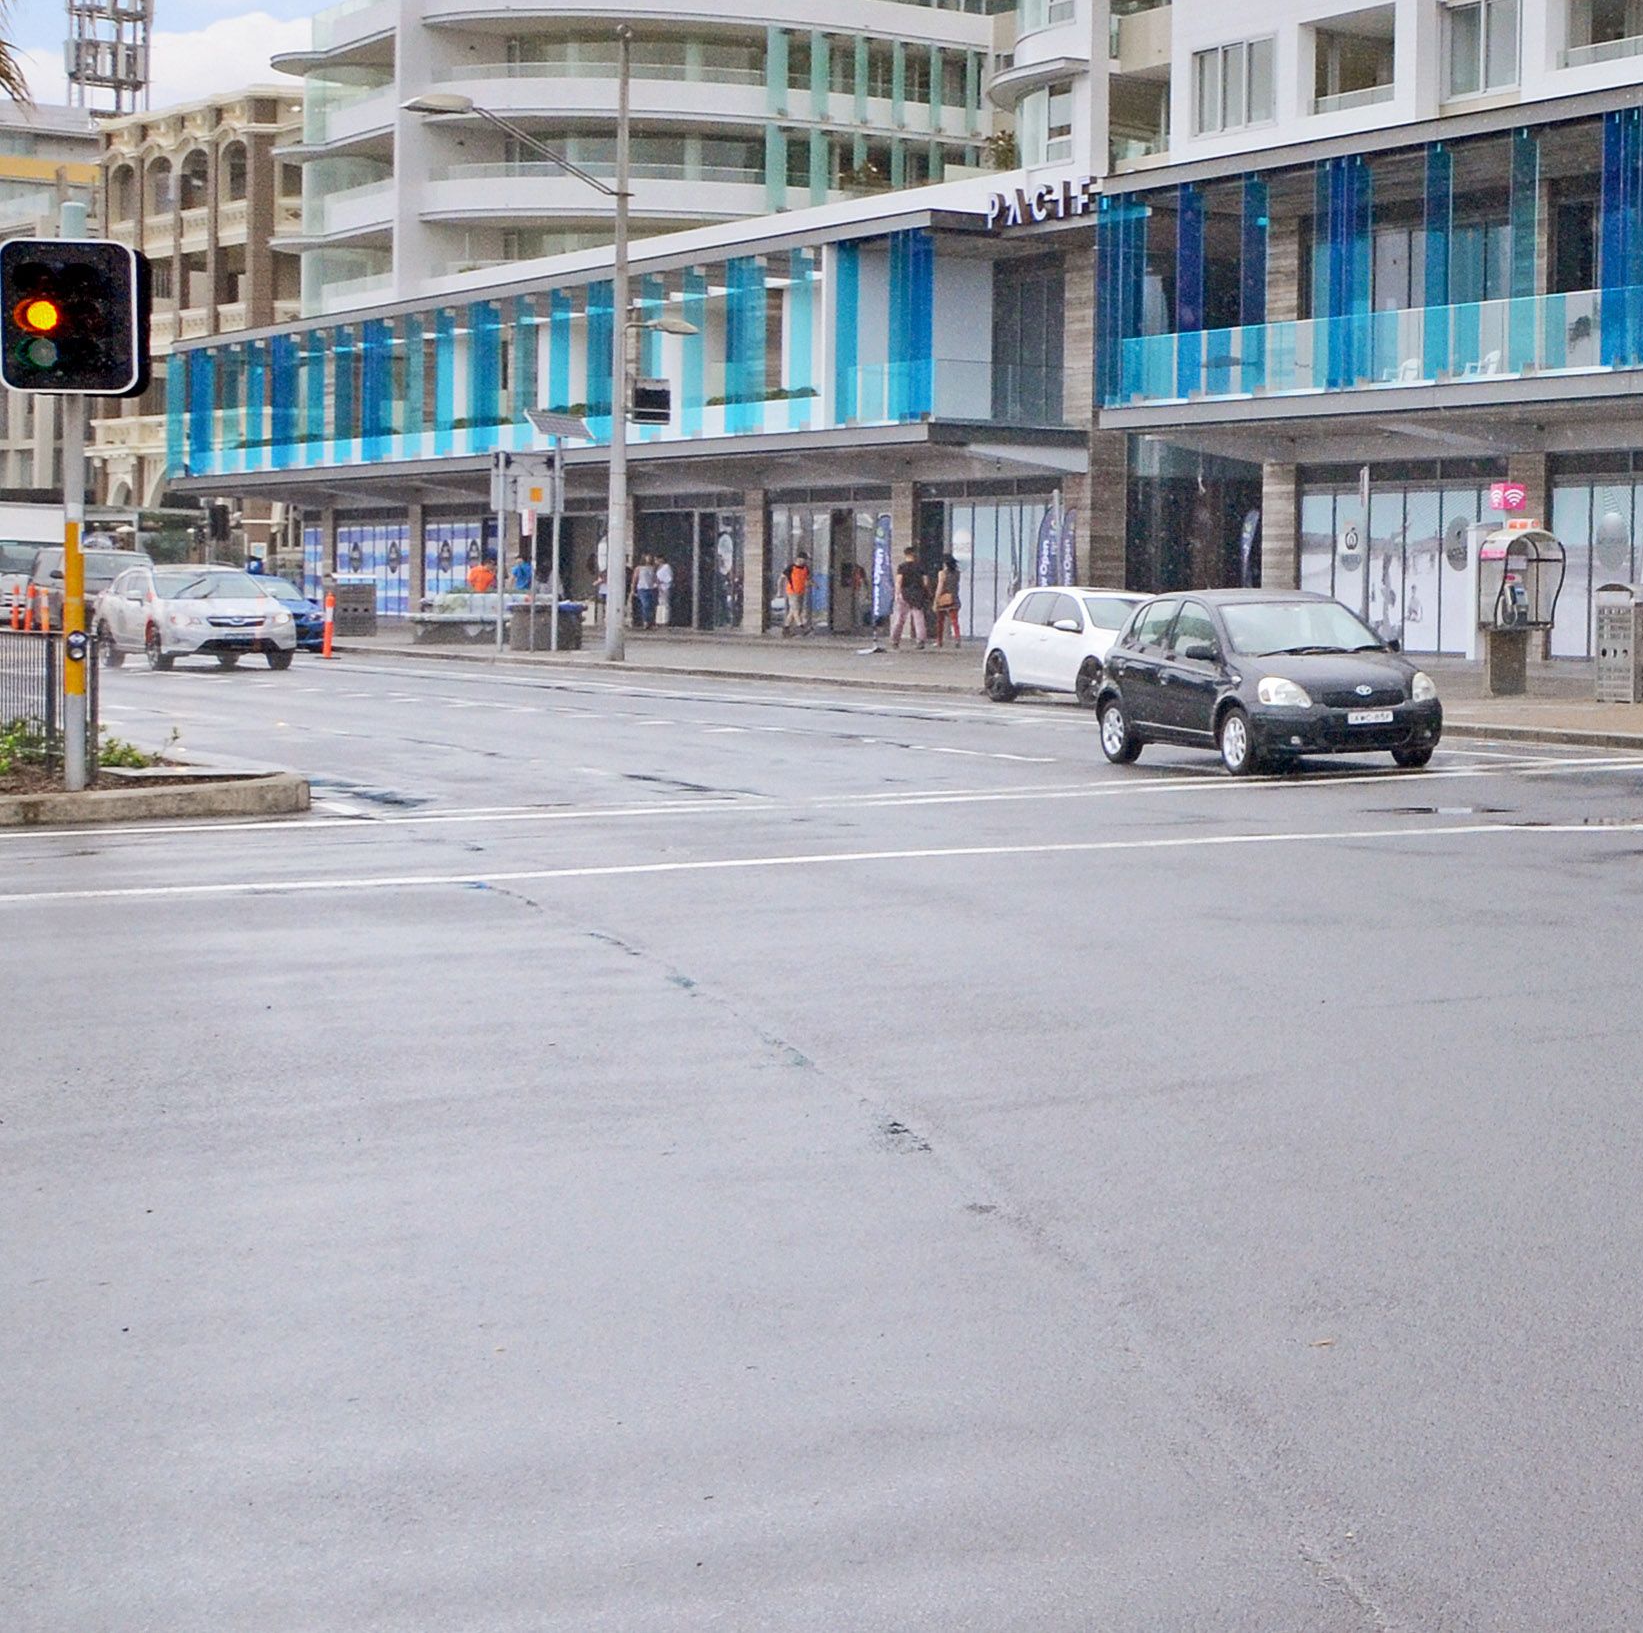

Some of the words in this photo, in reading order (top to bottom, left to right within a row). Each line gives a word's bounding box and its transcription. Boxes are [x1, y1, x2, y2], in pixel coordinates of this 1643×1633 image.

[987, 176, 1093, 229] PACIF
[873, 548, 884, 584] Open
[1039, 540, 1051, 575] Open
[1063, 539, 1072, 570] Open
